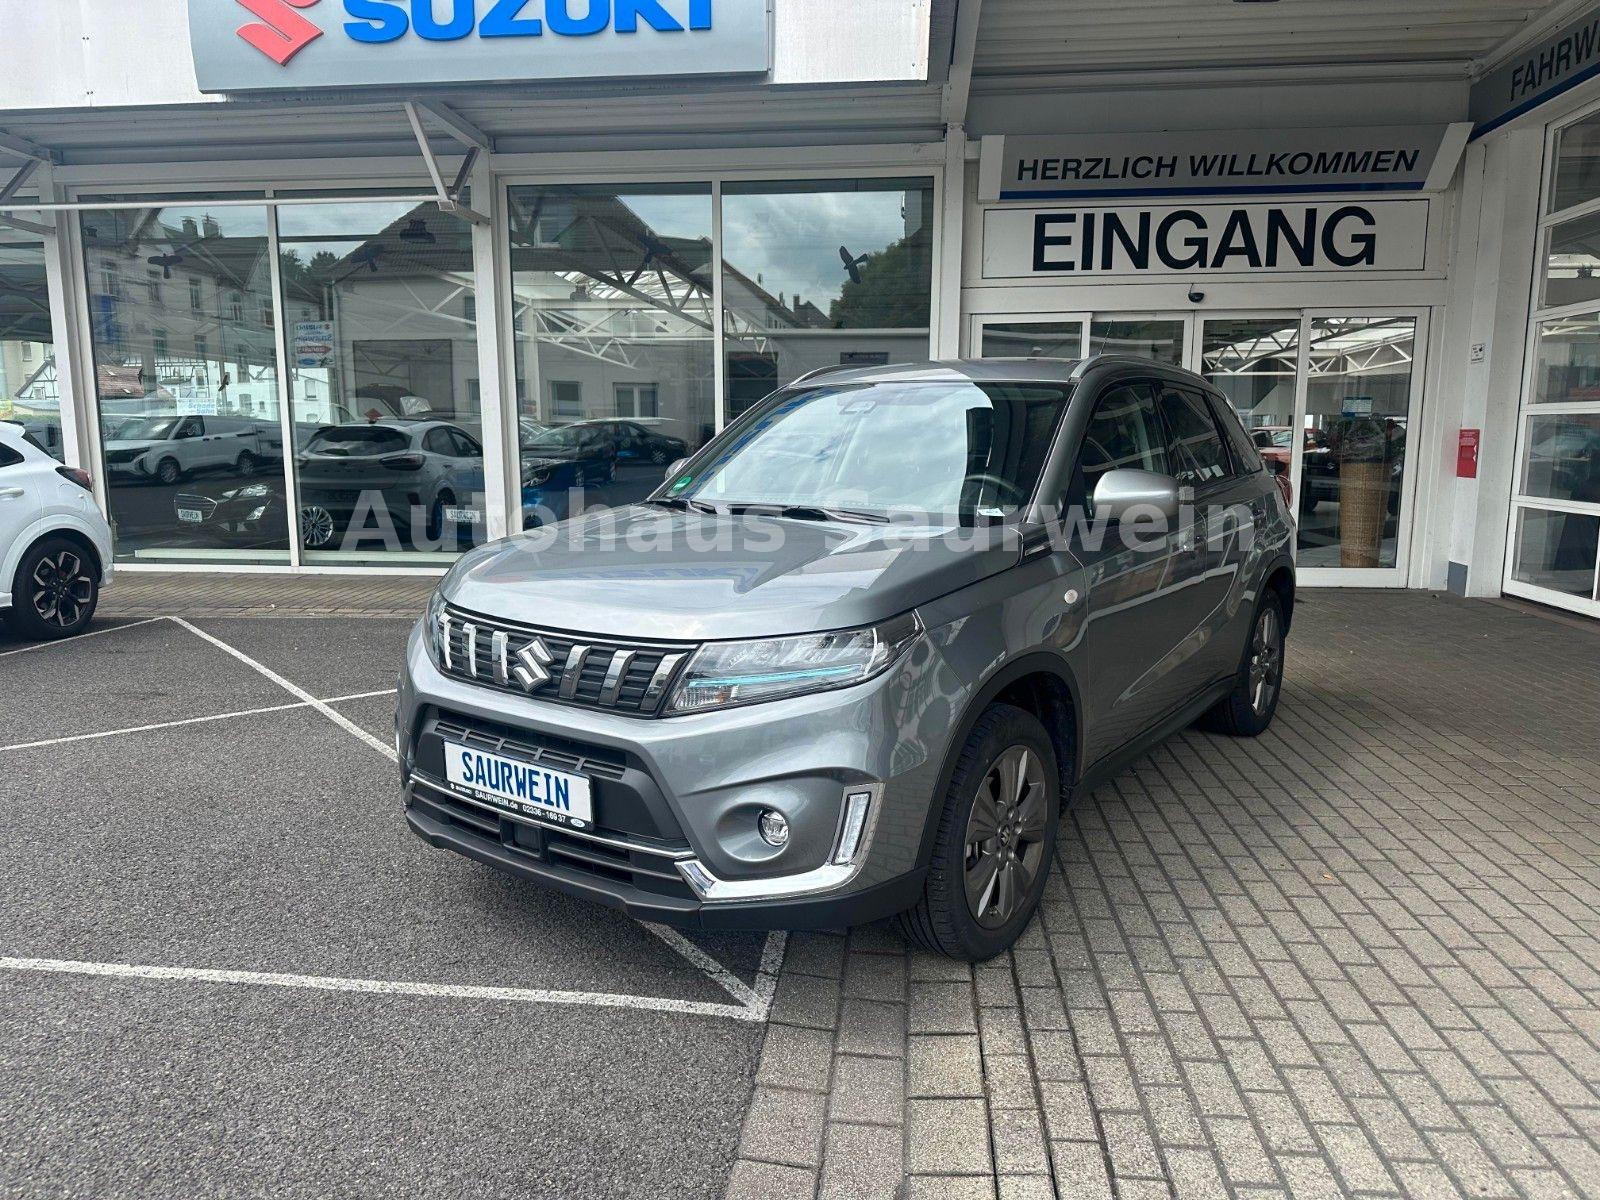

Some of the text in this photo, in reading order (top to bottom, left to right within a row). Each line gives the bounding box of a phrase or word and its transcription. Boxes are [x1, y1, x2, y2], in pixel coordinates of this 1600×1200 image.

[1511, 20, 1600, 101] FAHRW
[1017, 149, 1420, 181] HERZLICH WILLKOMMEN
[1032, 206, 1377, 271] EINGANG
[462, 752, 570, 811] SAURWEIN
[474, 790, 519, 810] SAURWEIN.de
